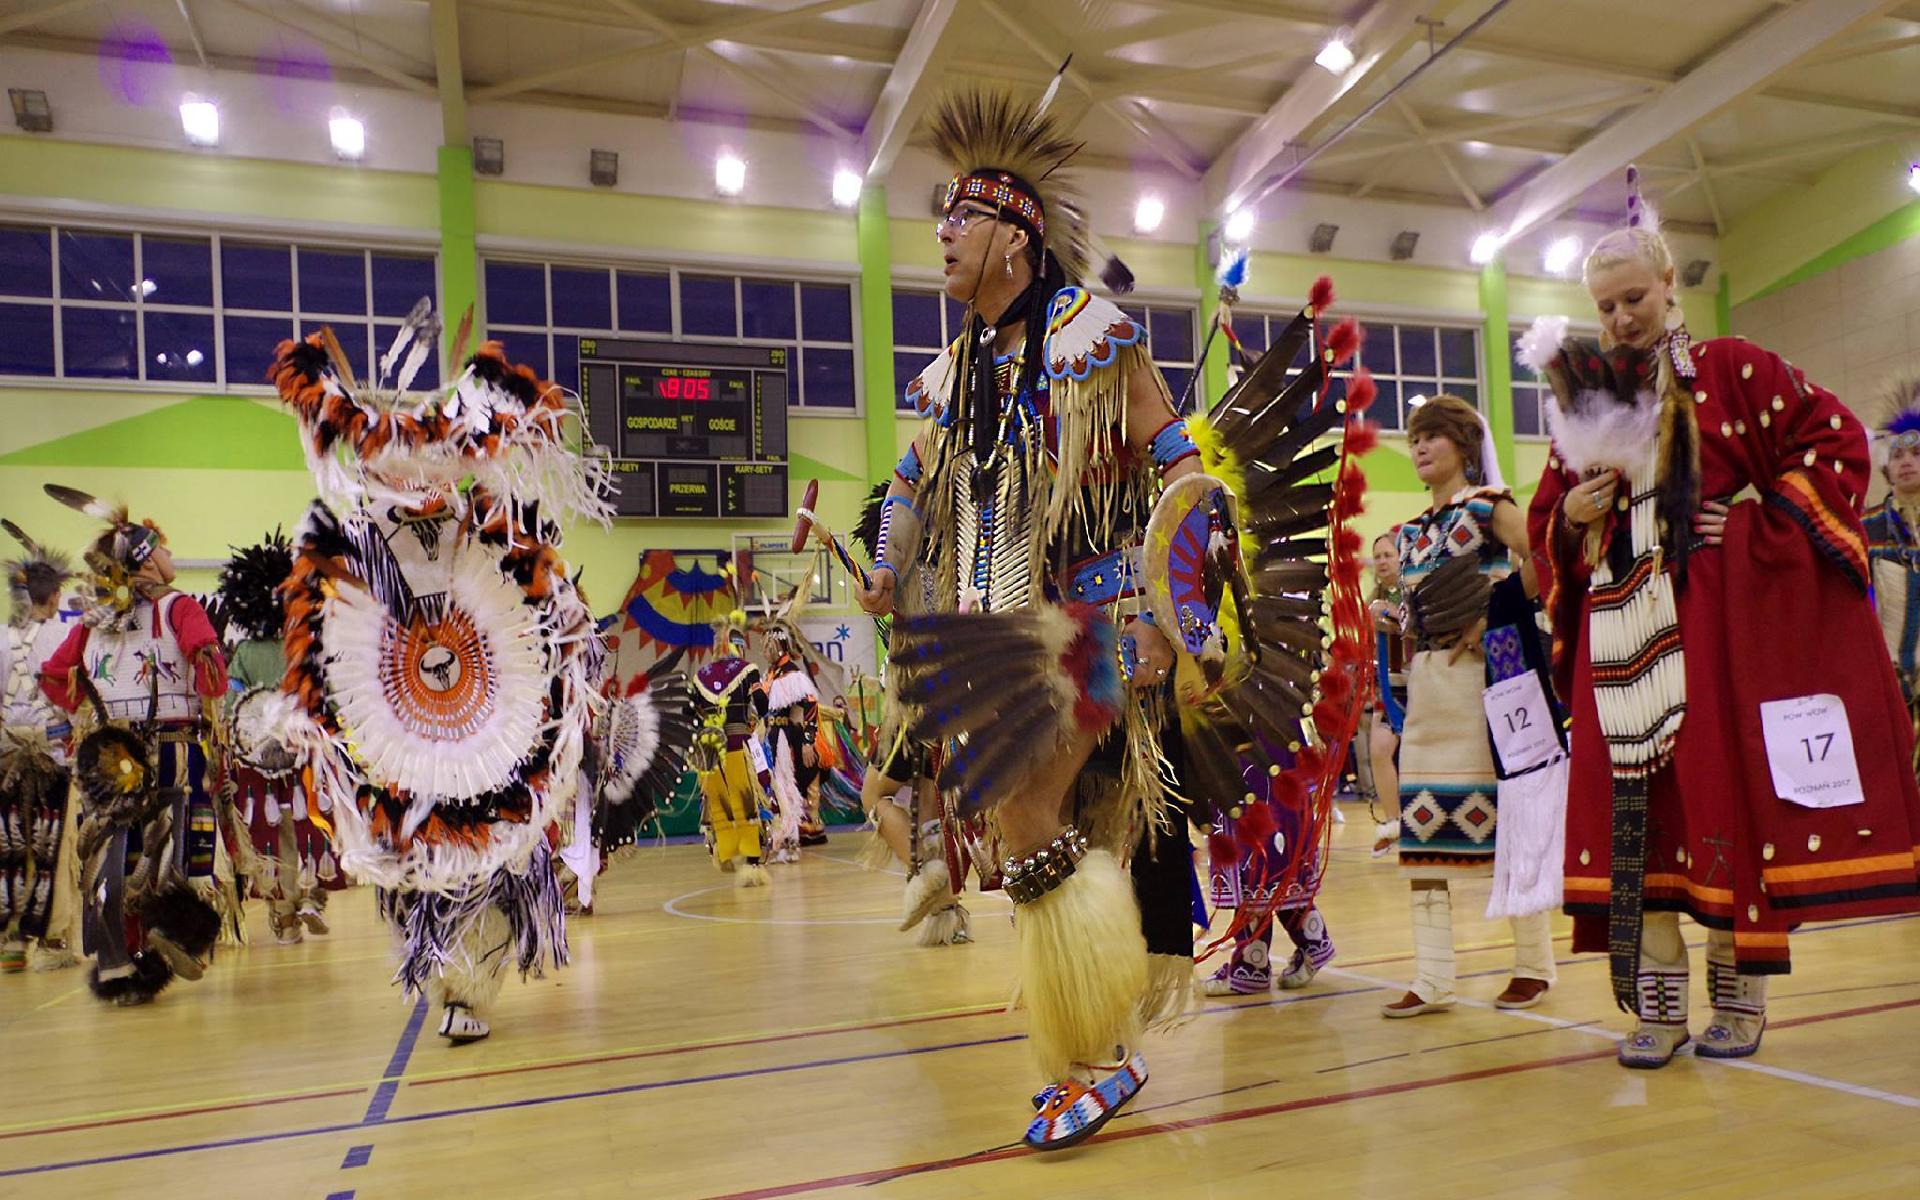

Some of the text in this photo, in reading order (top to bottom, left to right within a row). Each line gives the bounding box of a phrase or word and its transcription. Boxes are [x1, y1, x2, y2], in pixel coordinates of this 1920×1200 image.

[627, 417, 678, 430] GOSPODARZE
[708, 417, 736, 431] GOŚCIE
[669, 484, 707, 494] PRZERWA
[1503, 707, 1533, 733] 12
[1800, 732, 1835, 763] 17
